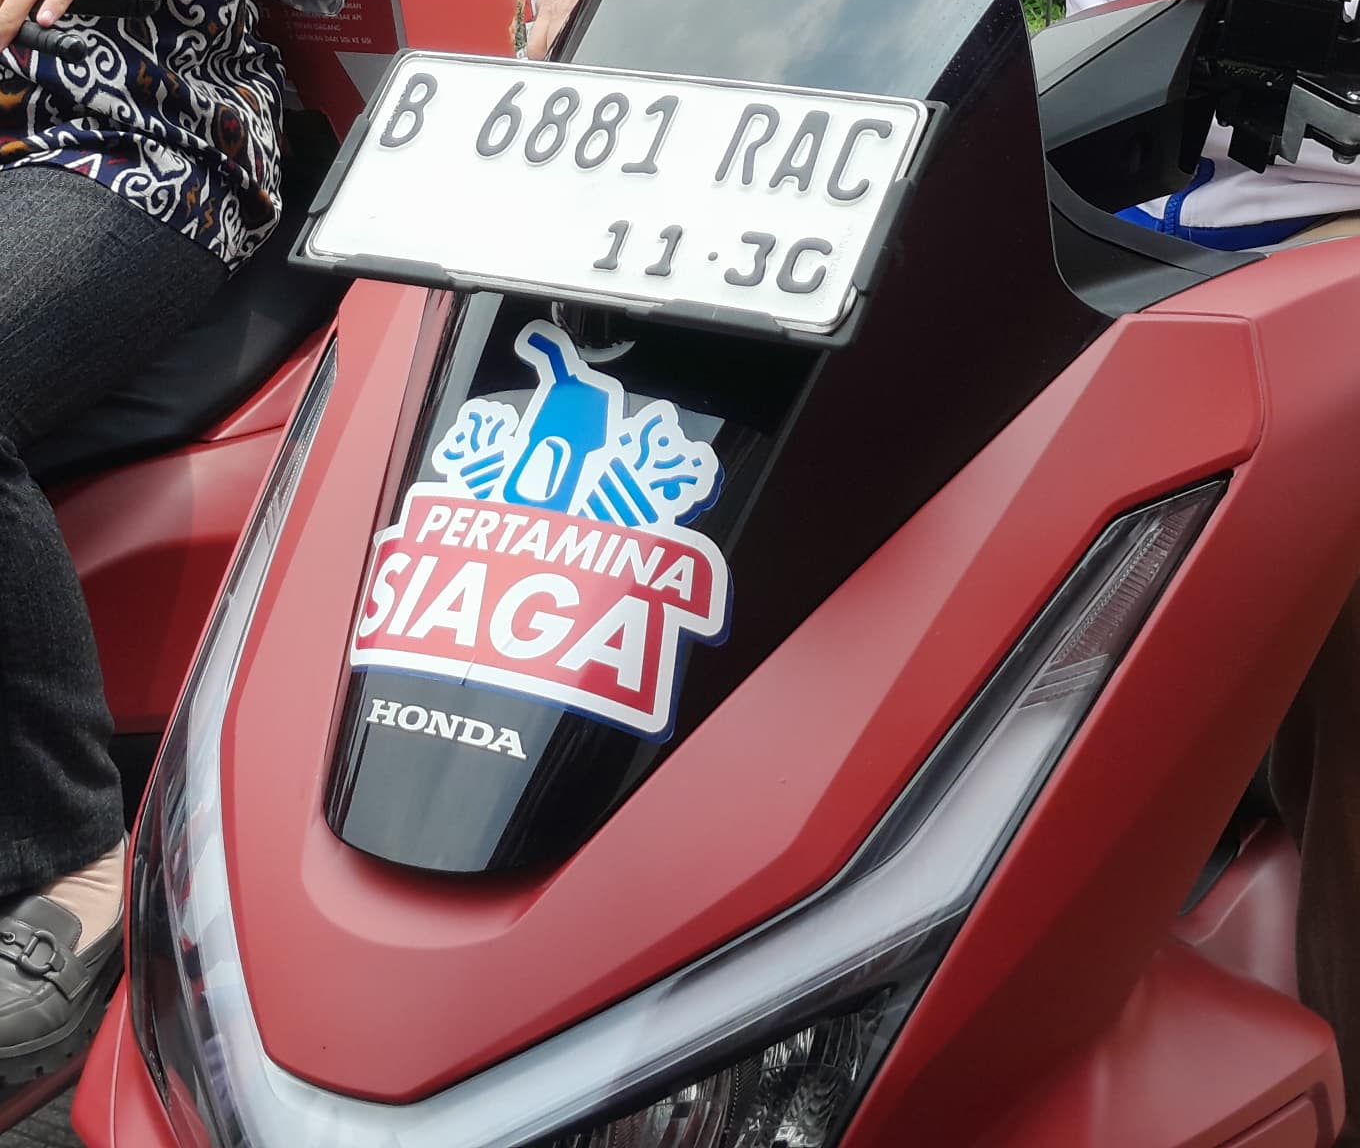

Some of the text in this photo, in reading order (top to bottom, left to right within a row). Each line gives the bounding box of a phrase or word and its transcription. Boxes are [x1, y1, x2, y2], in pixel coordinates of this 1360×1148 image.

[378, 72, 893, 201] B 6881 RAC
[416, 507, 696, 602] PERTAMINA
[358, 552, 650, 693] SIAGA
[366, 698, 527, 760] HONDA
